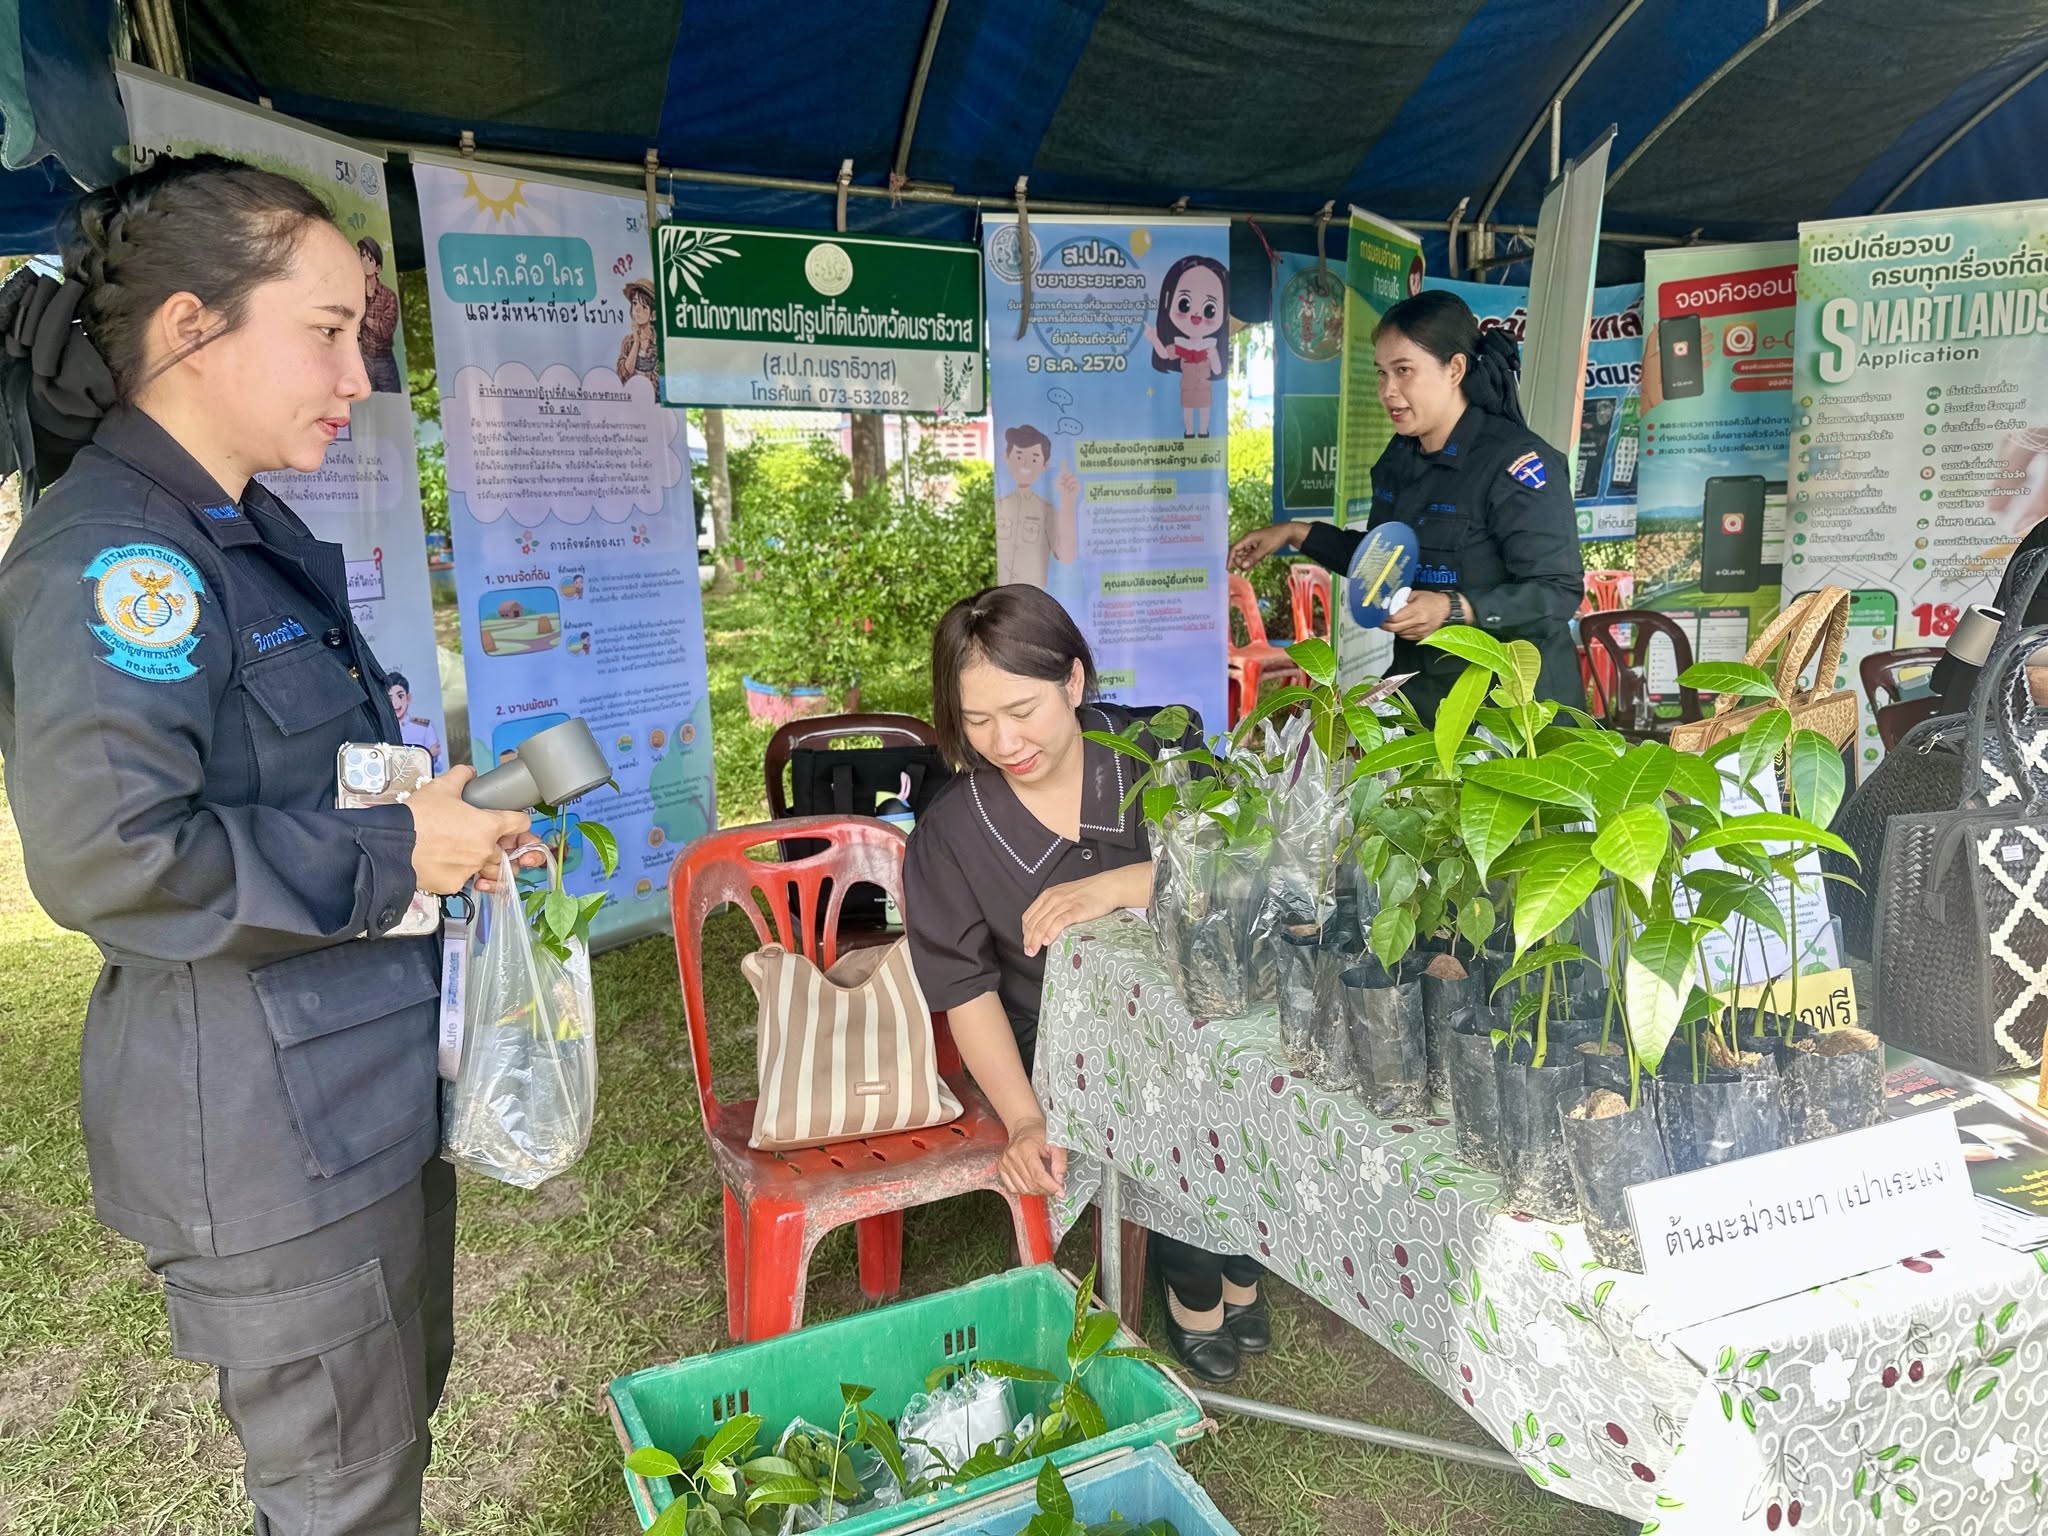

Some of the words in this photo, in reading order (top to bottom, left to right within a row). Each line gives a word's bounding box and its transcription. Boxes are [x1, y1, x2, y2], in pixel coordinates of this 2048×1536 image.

[1062, 240, 1126, 267] ส.ป.ก.
[1813, 233, 1951, 263] แอปเดียวจบ
[453, 252, 584, 287] ส.ป.ก.คือใคร
[1036, 272, 1145, 289] ขยายระยะเวลา
[465, 292, 624, 324] และมีหน้าที่อะไรบ้าง
[676, 296, 973, 344] สำนักงานการปฏิรูปที่ดินจังหวัดนราธิวาส
[1052, 330, 1127, 346] ยื่นได้จนถึงวันที่
[1045, 356, 1079, 373] ธ.ค.
[1083, 355, 1126, 373] 2570
[1857, 347, 1979, 370] Application
[763, 352, 897, 384] (ส.ป.ก.นราธิวาส)
[751, 381, 812, 402] โทรศัพท์
[819, 388, 909, 405] 073-532082
[1944, 402, 1985, 413] ร้องเรียน
[1994, 419, 2027, 430] จัดจ้าง
[1816, 430, 1893, 443] ค่าใช้จ่ายการรังวัด
[1080, 442, 1184, 458] ผู้ยื่นจะต้องมีคุณสมบัติ
[1817, 451, 1871, 461] LandsMaps
[1942, 444, 1962, 453] ถาม
[1971, 442, 1993, 451] ตอบ
[1080, 453, 1197, 468] และเตรียมเอกสารหลักฐาน
[1200, 450, 1221, 463] ดังนี้
[1089, 483, 1172, 500] ผู้ที่สามารถยื่นคำขอ
[1937, 500, 1984, 509] งานบริการ
[1935, 516, 1963, 527] ค้นหา
[550, 536, 625, 551] ภารกิจหลักของเรา
[100, 548, 193, 578] กรมทหารพราน
[497, 565, 550, 584] งานจัดที่ดิน
[1104, 573, 1204, 590] คุณสมบัติของผู้ยื่นคำขอ
[125, 659, 181, 676] กองทัพเรือ
[508, 698, 558, 715] งานพัฒนา
[1784, 986, 1852, 1030] กฟรี
[1665, 1193, 1828, 1256] ต้นมะม่วงเบา
